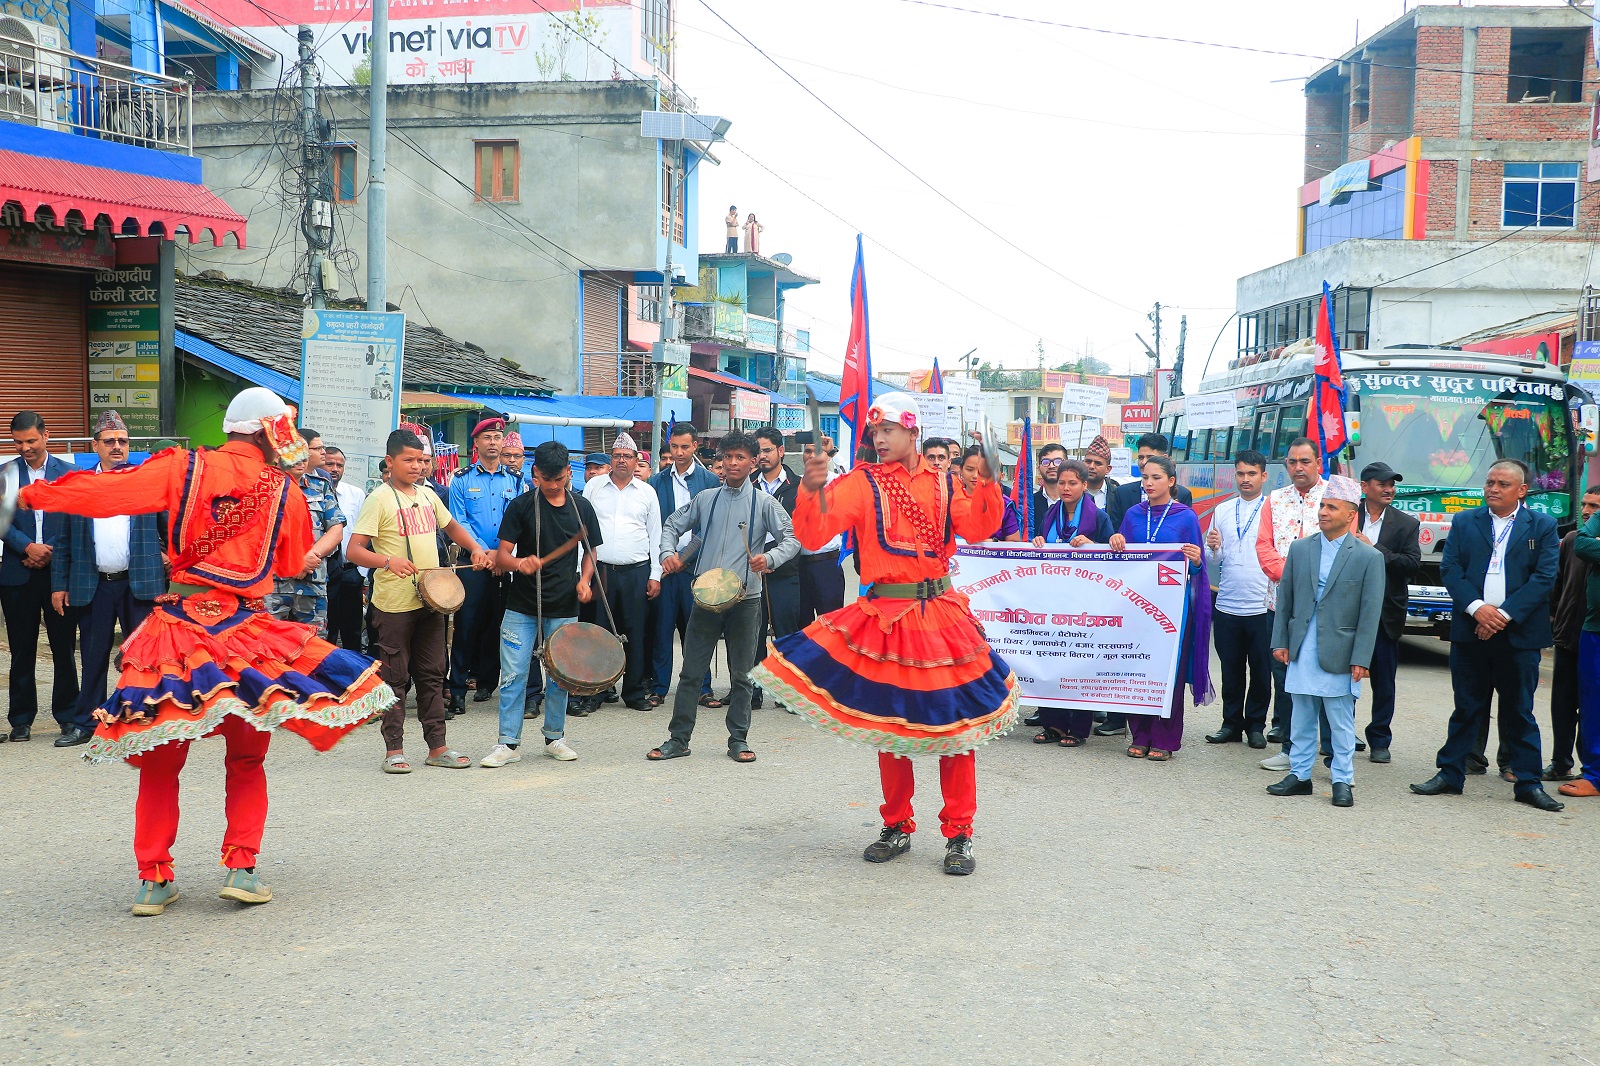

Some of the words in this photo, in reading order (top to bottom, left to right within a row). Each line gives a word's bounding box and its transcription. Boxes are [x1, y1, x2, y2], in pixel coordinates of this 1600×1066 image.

[342, 25, 436, 54] vinet
[405, 57, 428, 77] को
[438, 59, 475, 77] साथ
[95, 267, 152, 284] प्रकाशदीप
[90, 286, 126, 302] फेन्सी
[128, 285, 158, 302] स्टोर
[137, 342, 159, 350] Lakhani
[1360, 373, 1422, 391] सुन्दर
[1427, 375, 1475, 394] सुदूर
[1481, 376, 1551, 397] पश्चिम
[1429, 395, 1463, 404] यातायात
[1124, 408, 1151, 418] ATM
[1391, 497, 1432, 512] गढी
[396, 504, 437, 536] CHILLIN
[1419, 512, 1447, 523] V.I.P.
[957, 569, 1012, 596] निजामती
[1014, 566, 1037, 578] सेवा
[1041, 563, 1072, 577] दिवस
[1074, 567, 1104, 584] २०८२
[1105, 577, 1124, 592] को
[1121, 587, 1178, 634] उपलक्ष्यमा
[974, 607, 1048, 625] आयोजित
[1051, 612, 1124, 628] कार्यक्रम
[1069, 651, 1094, 659] वितरण
[1120, 652, 1151, 660] समारोह
